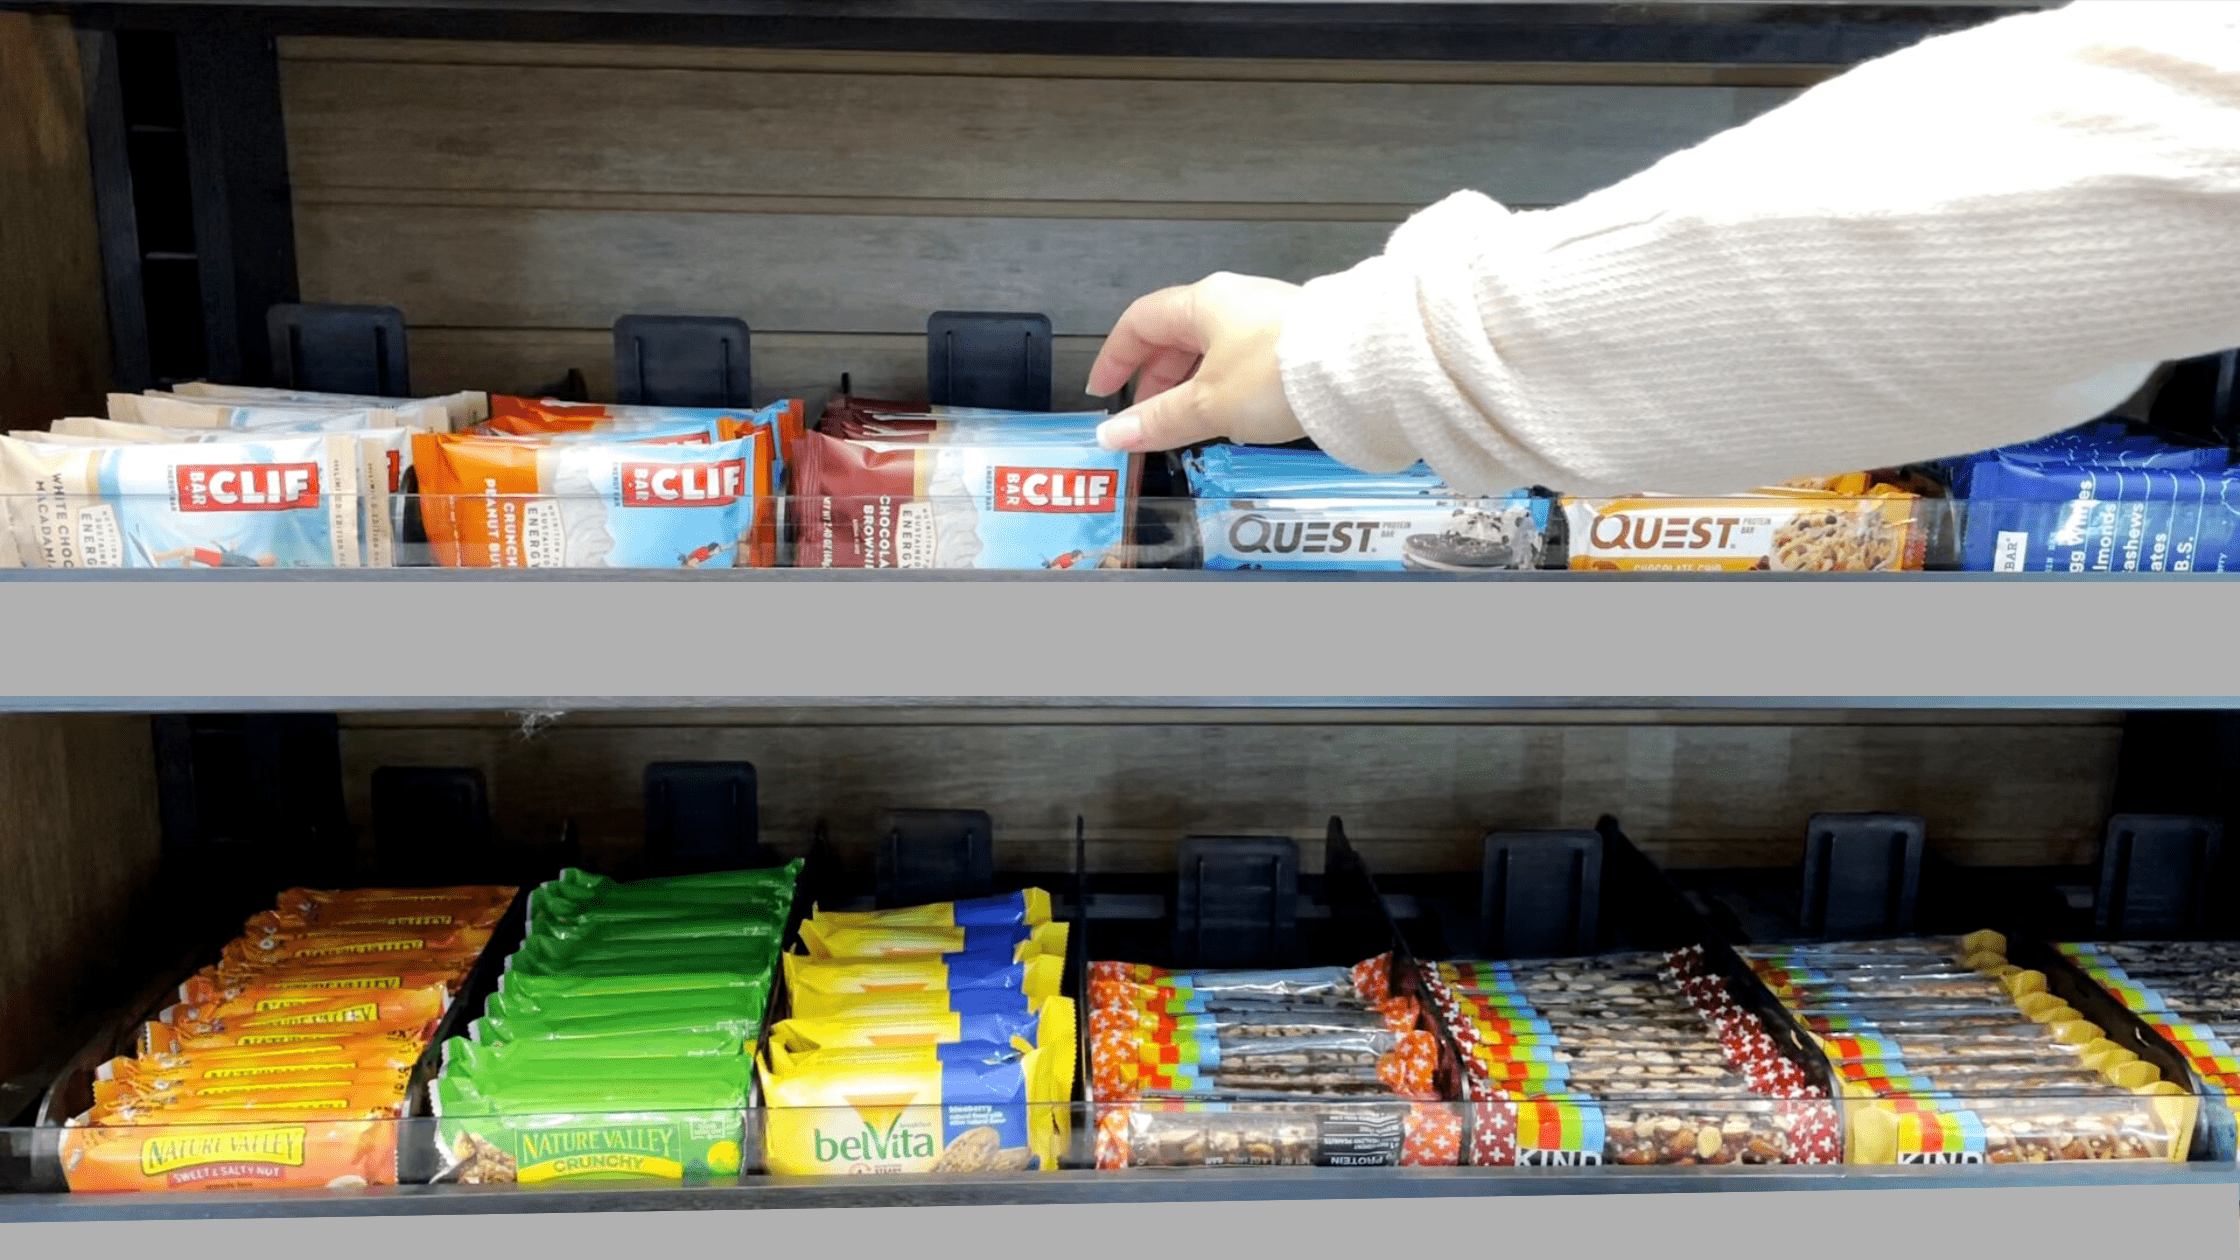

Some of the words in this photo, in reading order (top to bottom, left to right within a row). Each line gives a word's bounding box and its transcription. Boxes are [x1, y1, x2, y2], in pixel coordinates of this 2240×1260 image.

[52, 472, 68, 520] WHITE
[189, 470, 207, 505] BAR
[208, 469, 309, 505] CLIF
[634, 468, 649, 501] BAR
[652, 466, 741, 501] CLIF
[1006, 473, 1021, 506] BAR
[1022, 473, 1110, 506] CLIF
[484, 477, 500, 538] PEANUT
[58, 525, 75, 568] CHOC
[879, 495, 891, 568] CHOCOLA
[1229, 514, 1379, 554] QUEST
[1590, 514, 1740, 549] QUEST
[2122, 502, 2145, 572] ashews
[2150, 533, 2167, 571] ates
[2173, 536, 2194, 571] B.S.
[149, 1137, 221, 1169] NATURE
[230, 1131, 296, 1161] VALLEY
[522, 1130, 599, 1163] NATURE
[602, 1127, 673, 1158] VALLEY
[814, 1113, 934, 1162] belVita
[173, 1166, 209, 1183] SWEET
[220, 1165, 254, 1178] SALTY
[256, 1166, 280, 1177] NUT
[552, 1154, 645, 1173] CRUNCHY
[1515, 1149, 1603, 1167] KIND
